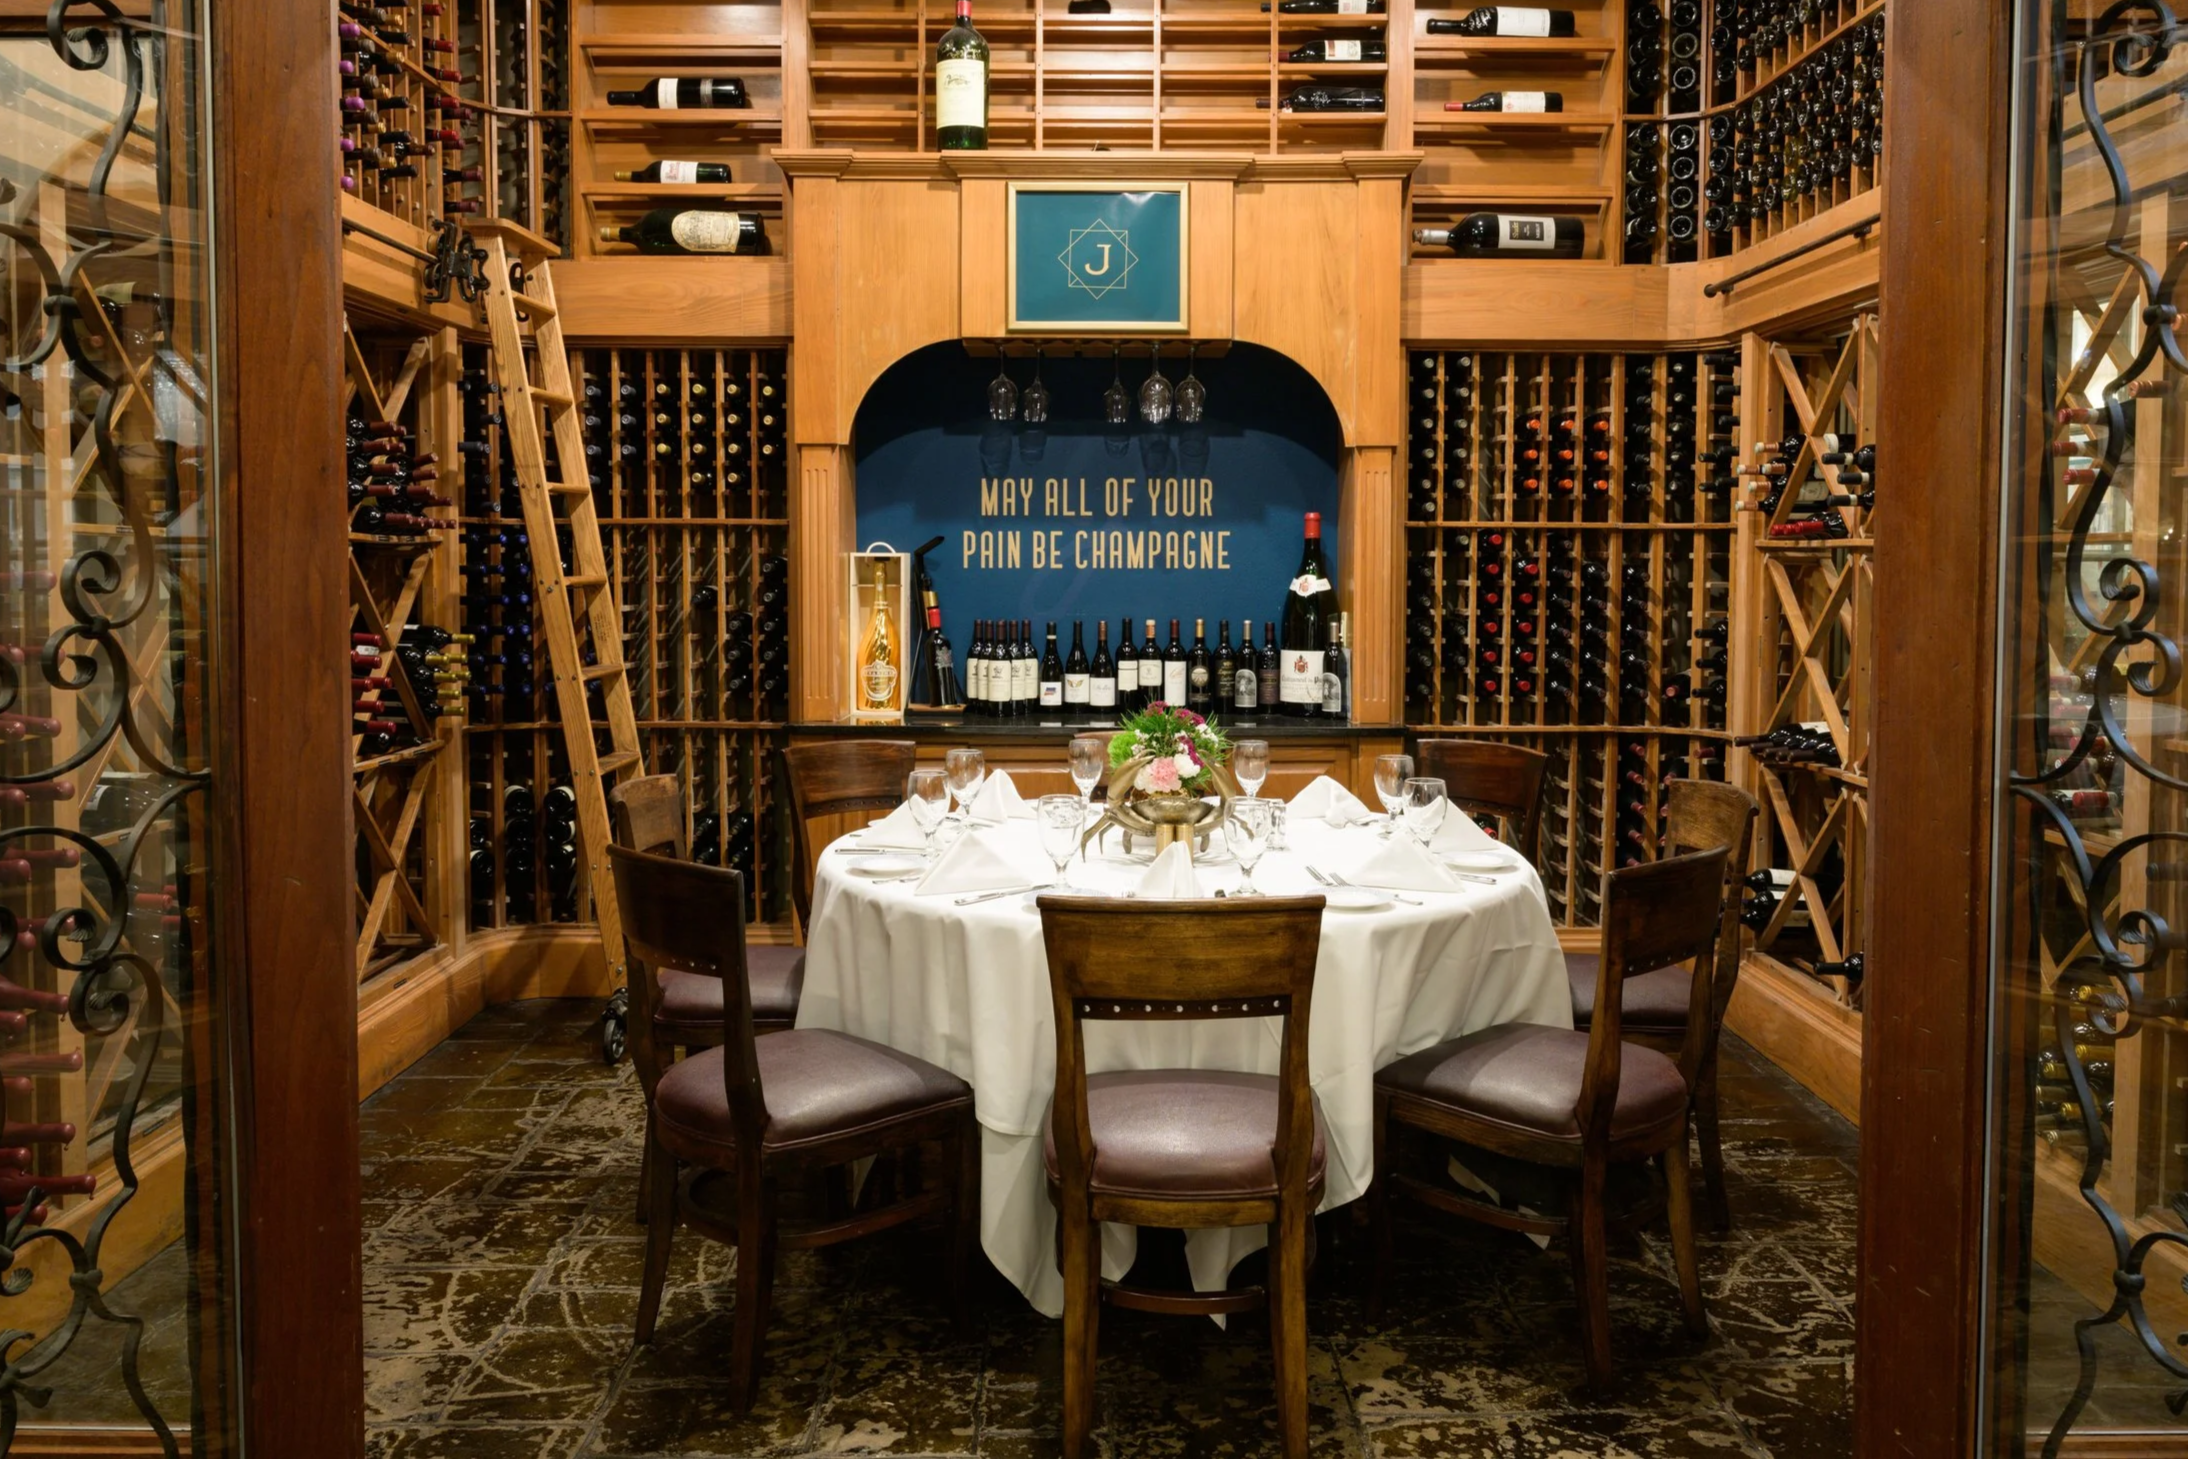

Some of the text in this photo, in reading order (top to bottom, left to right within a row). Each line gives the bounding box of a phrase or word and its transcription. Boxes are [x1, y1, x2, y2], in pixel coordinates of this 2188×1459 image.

[1084, 243, 1112, 276] J
[980, 477, 1214, 517] MAY ALL OF YOUR
[962, 530, 1231, 570] PAIN BE CHAMPAGNE
